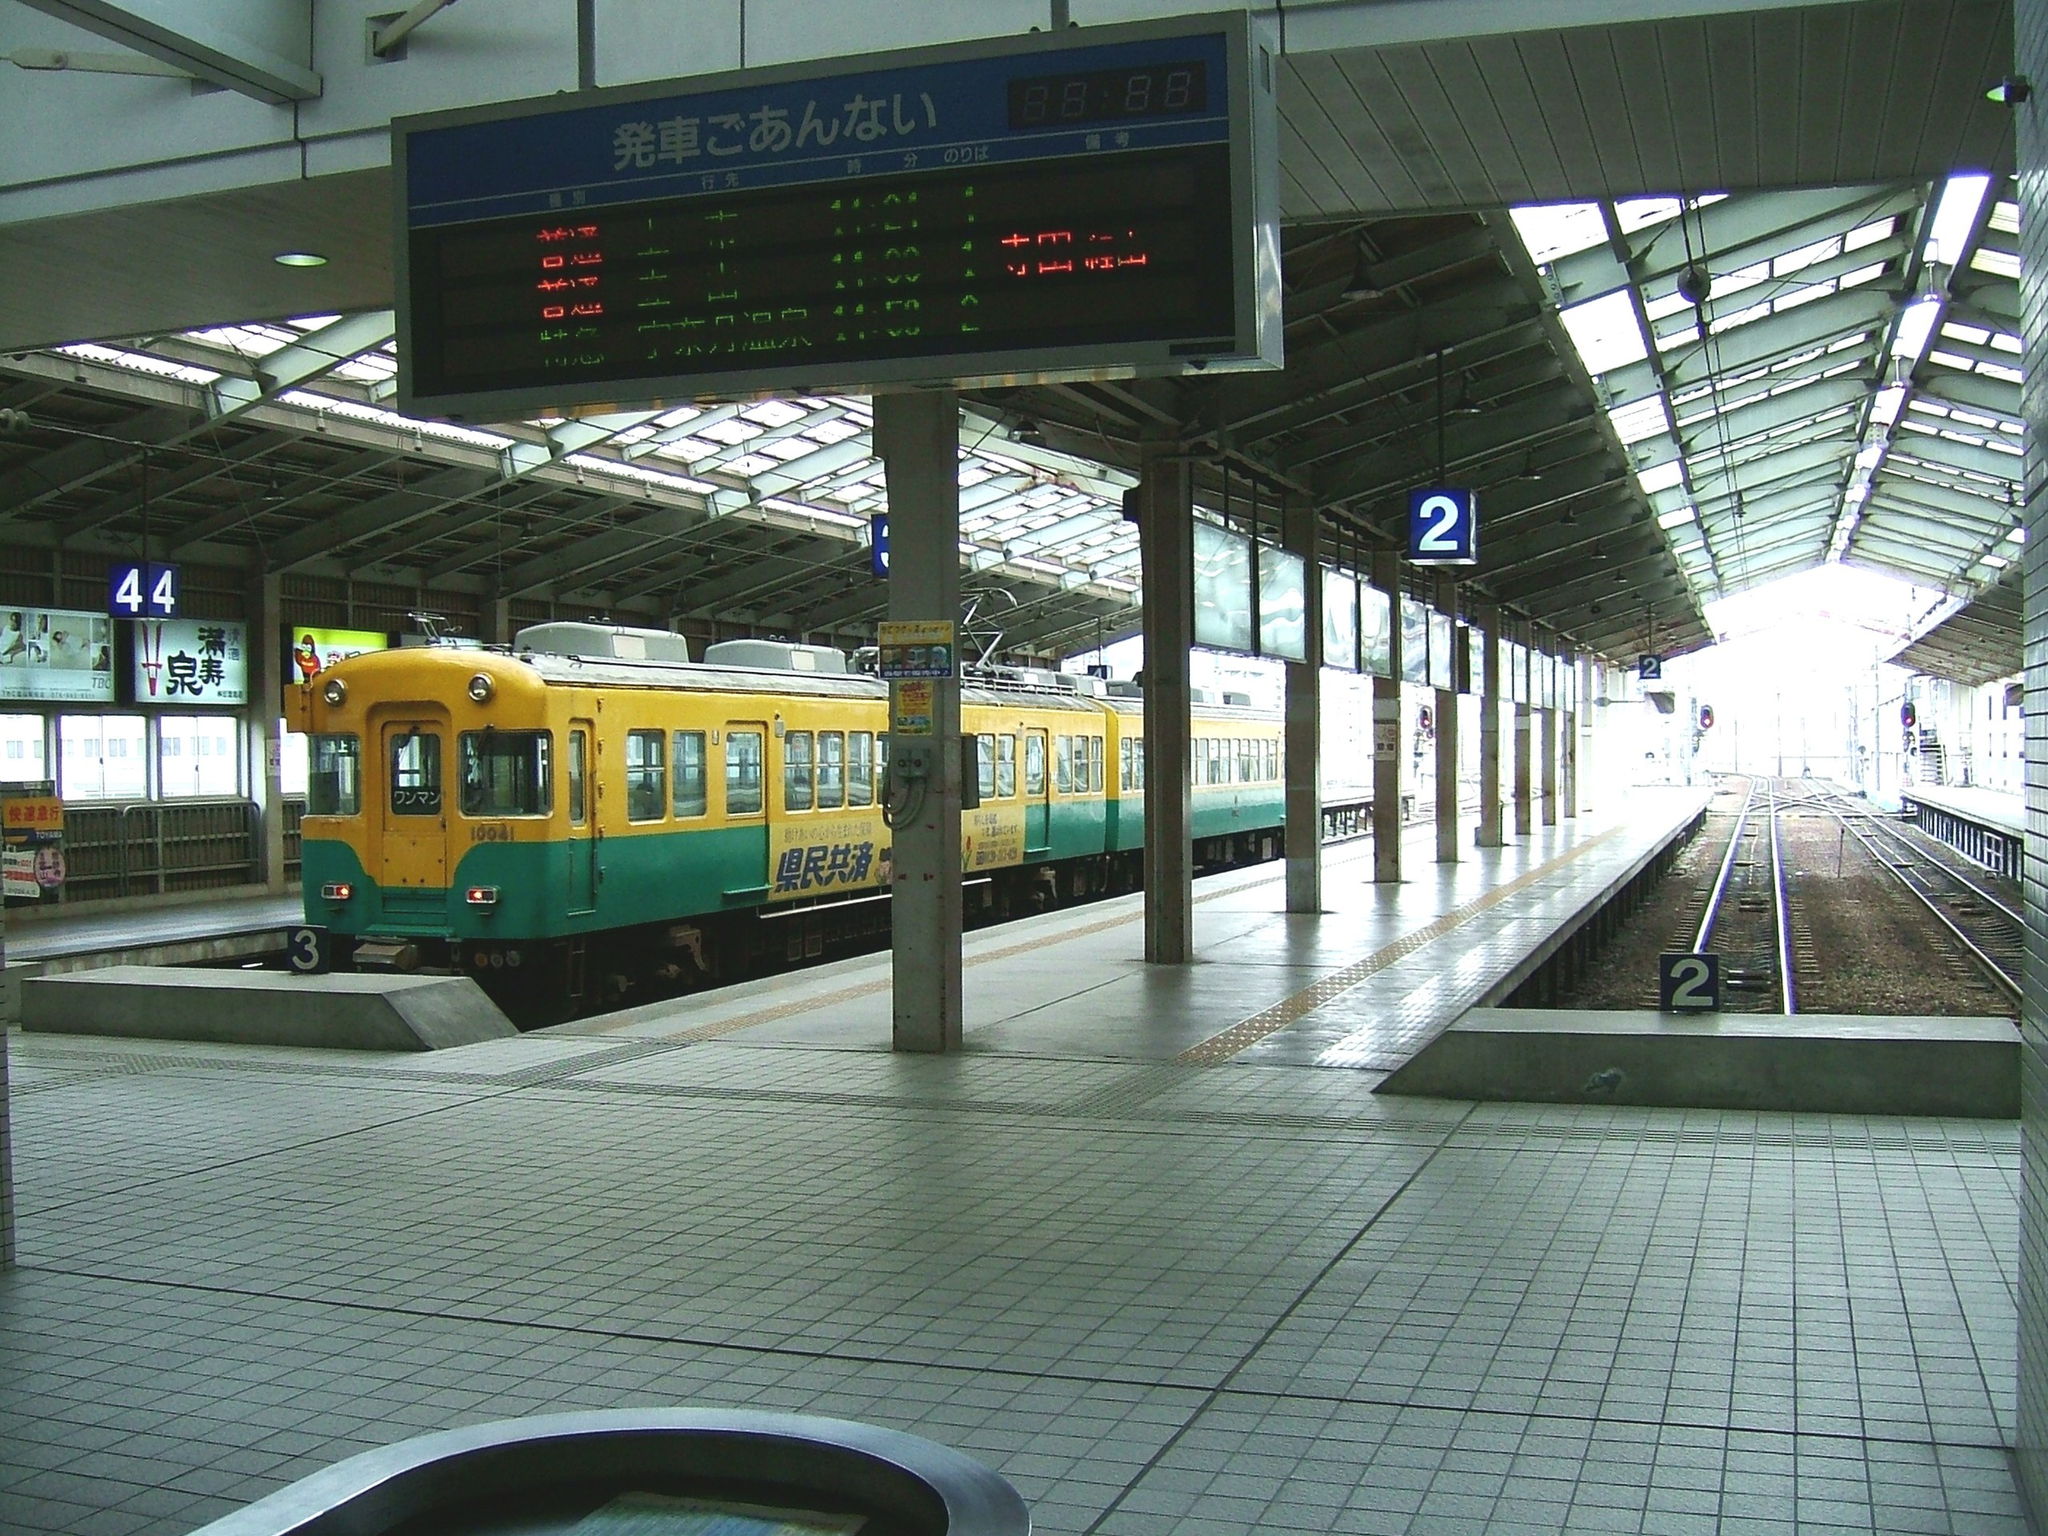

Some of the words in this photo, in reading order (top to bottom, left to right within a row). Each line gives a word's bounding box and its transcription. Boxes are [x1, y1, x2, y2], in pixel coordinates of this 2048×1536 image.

[612, 92, 938, 171] 発車ごあんない
[701, 172, 739, 190] 行先
[903, 153, 918, 169] 分
[1419, 494, 1459, 552] 2
[116, 568, 143, 612] 4
[152, 569, 175, 613] 4
[1642, 657, 1659, 677] 2
[394, 790, 441, 805] ワンマン
[773, 841, 875, 894] 県民共済
[292, 929, 319, 970] 3
[1669, 957, 1713, 1006] 2
